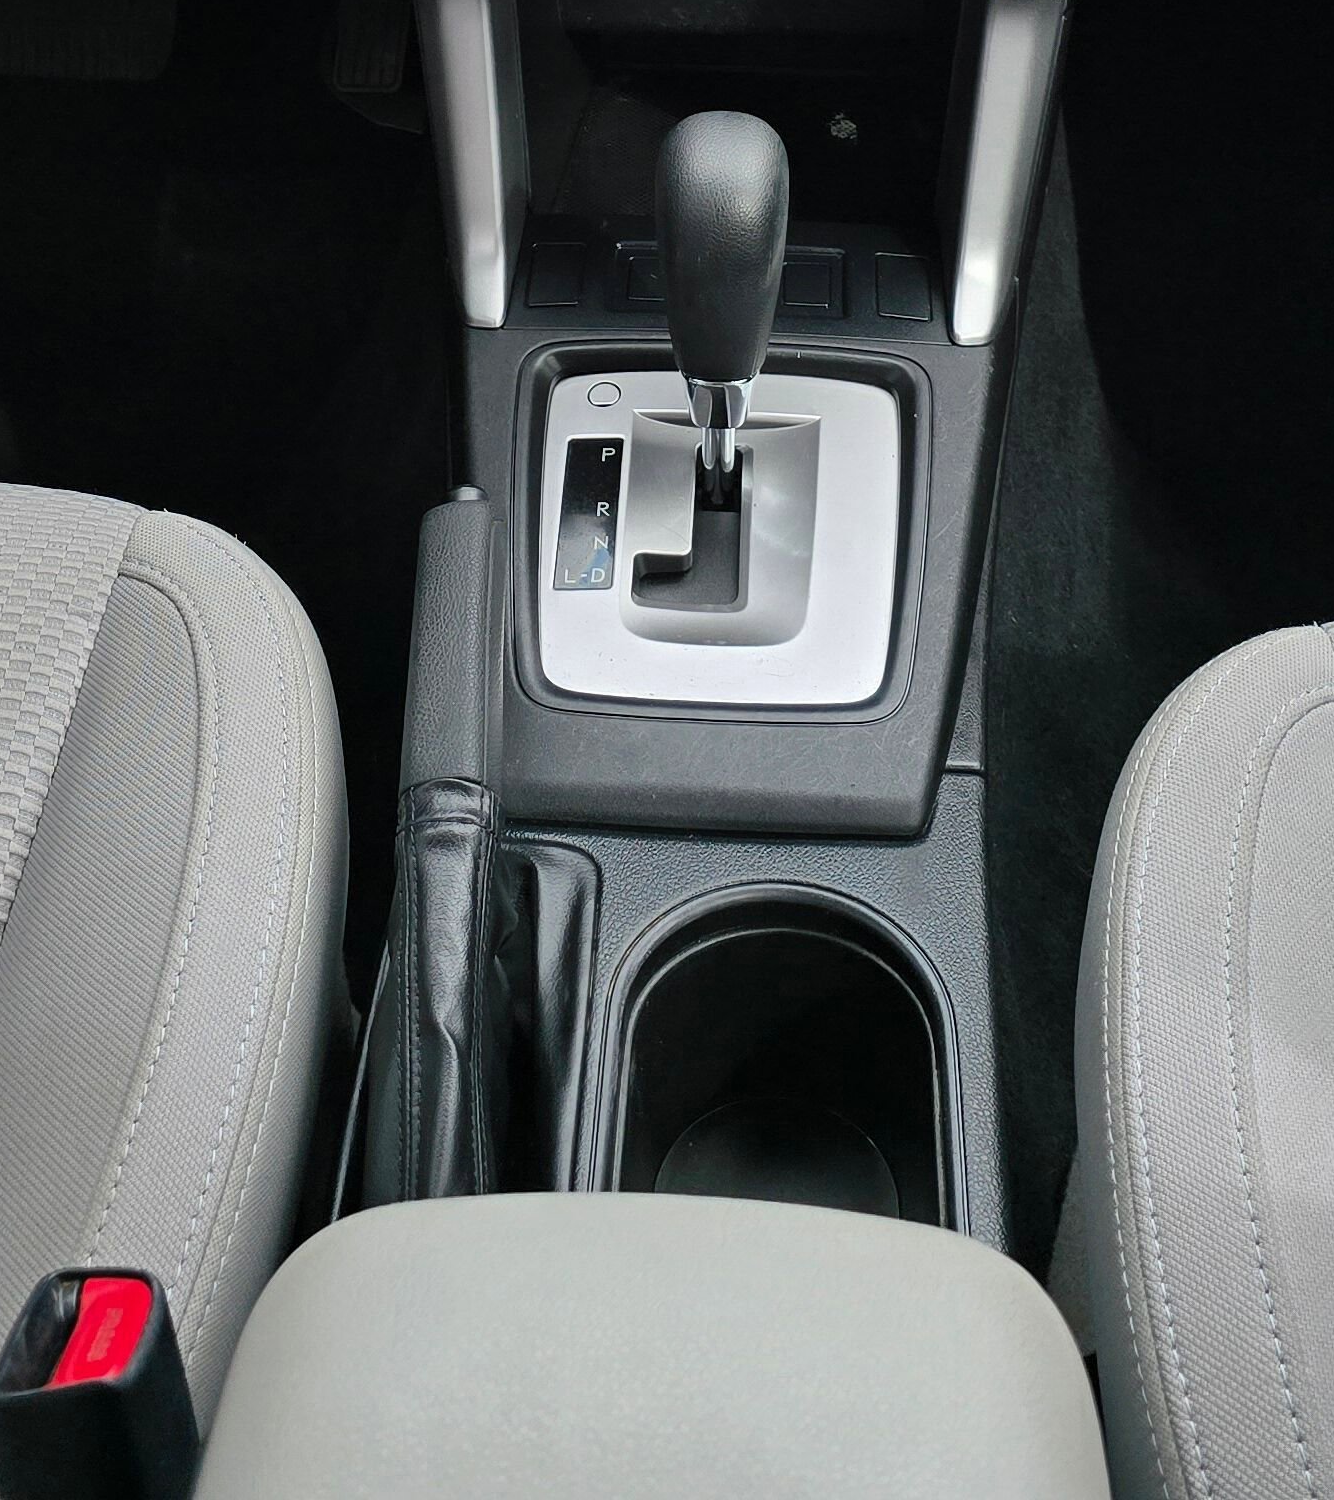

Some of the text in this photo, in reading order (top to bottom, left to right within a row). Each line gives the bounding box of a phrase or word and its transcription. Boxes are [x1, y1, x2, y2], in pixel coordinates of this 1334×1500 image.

[602, 448, 616, 462] P
[597, 501, 610, 517] R
[594, 536, 609, 550] N
[564, 568, 606, 583] L D
